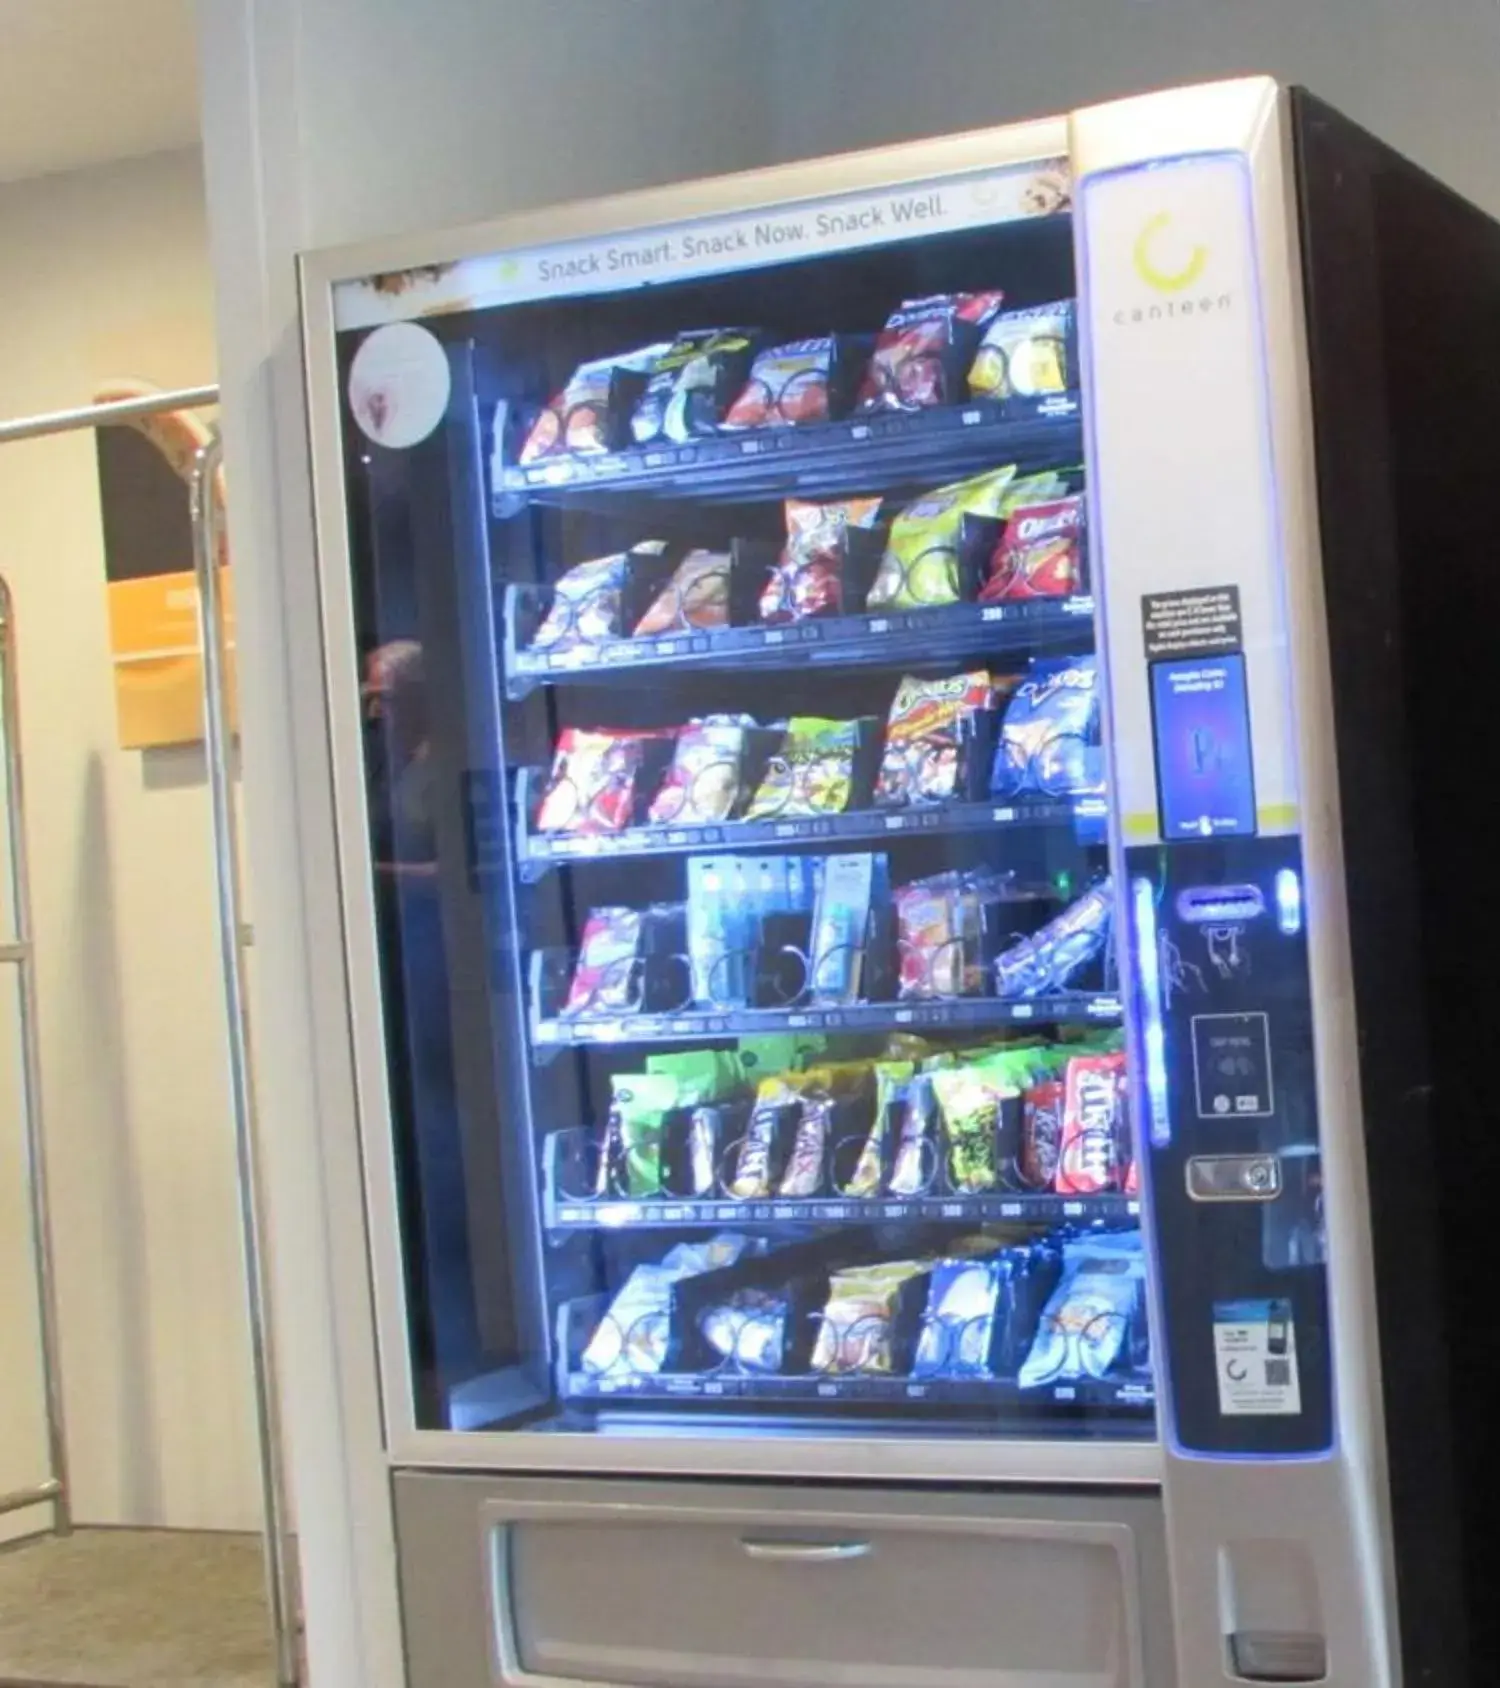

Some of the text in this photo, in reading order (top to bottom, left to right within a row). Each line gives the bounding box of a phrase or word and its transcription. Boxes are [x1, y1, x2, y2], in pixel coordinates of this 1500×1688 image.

[538, 195, 948, 282] Snack Smart. Snack Now. Snack Well.
[1112, 293, 1232, 326] canteen
